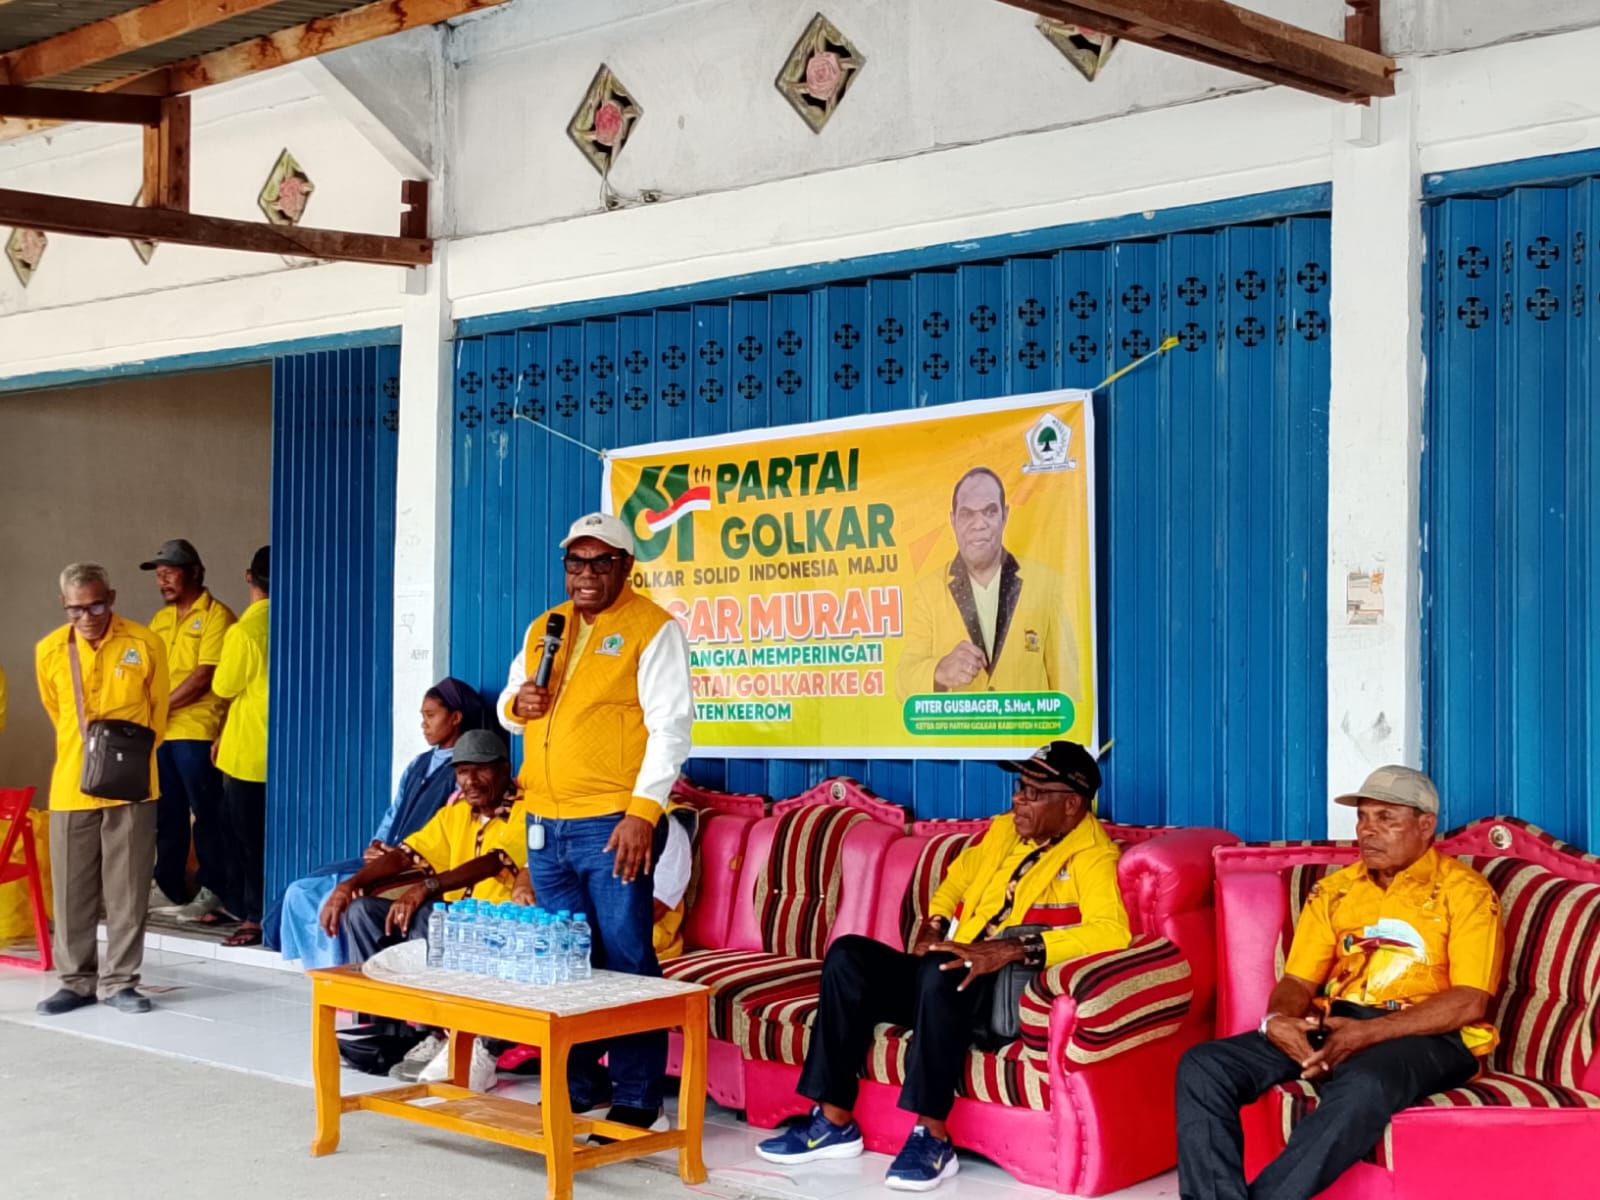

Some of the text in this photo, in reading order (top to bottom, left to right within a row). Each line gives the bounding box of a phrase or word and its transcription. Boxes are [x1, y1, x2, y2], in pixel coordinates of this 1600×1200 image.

[716, 448, 859, 504] PARTAI
[721, 503, 896, 560] GOLKAR
[627, 553, 899, 589] OLKAR SOLID INDONESIA MAJU
[667, 586, 902, 643] SAR MURAH
[690, 643, 882, 668] ANGKA MEMPERINGATI
[691, 670, 884, 697] RTAI GOLKAR KE 61
[727, 703, 792, 720] KEEROM
[914, 699, 942, 713] PITER
[944, 699, 1002, 715] GUSBAGER,
[1036, 698, 1061, 713] MUP
